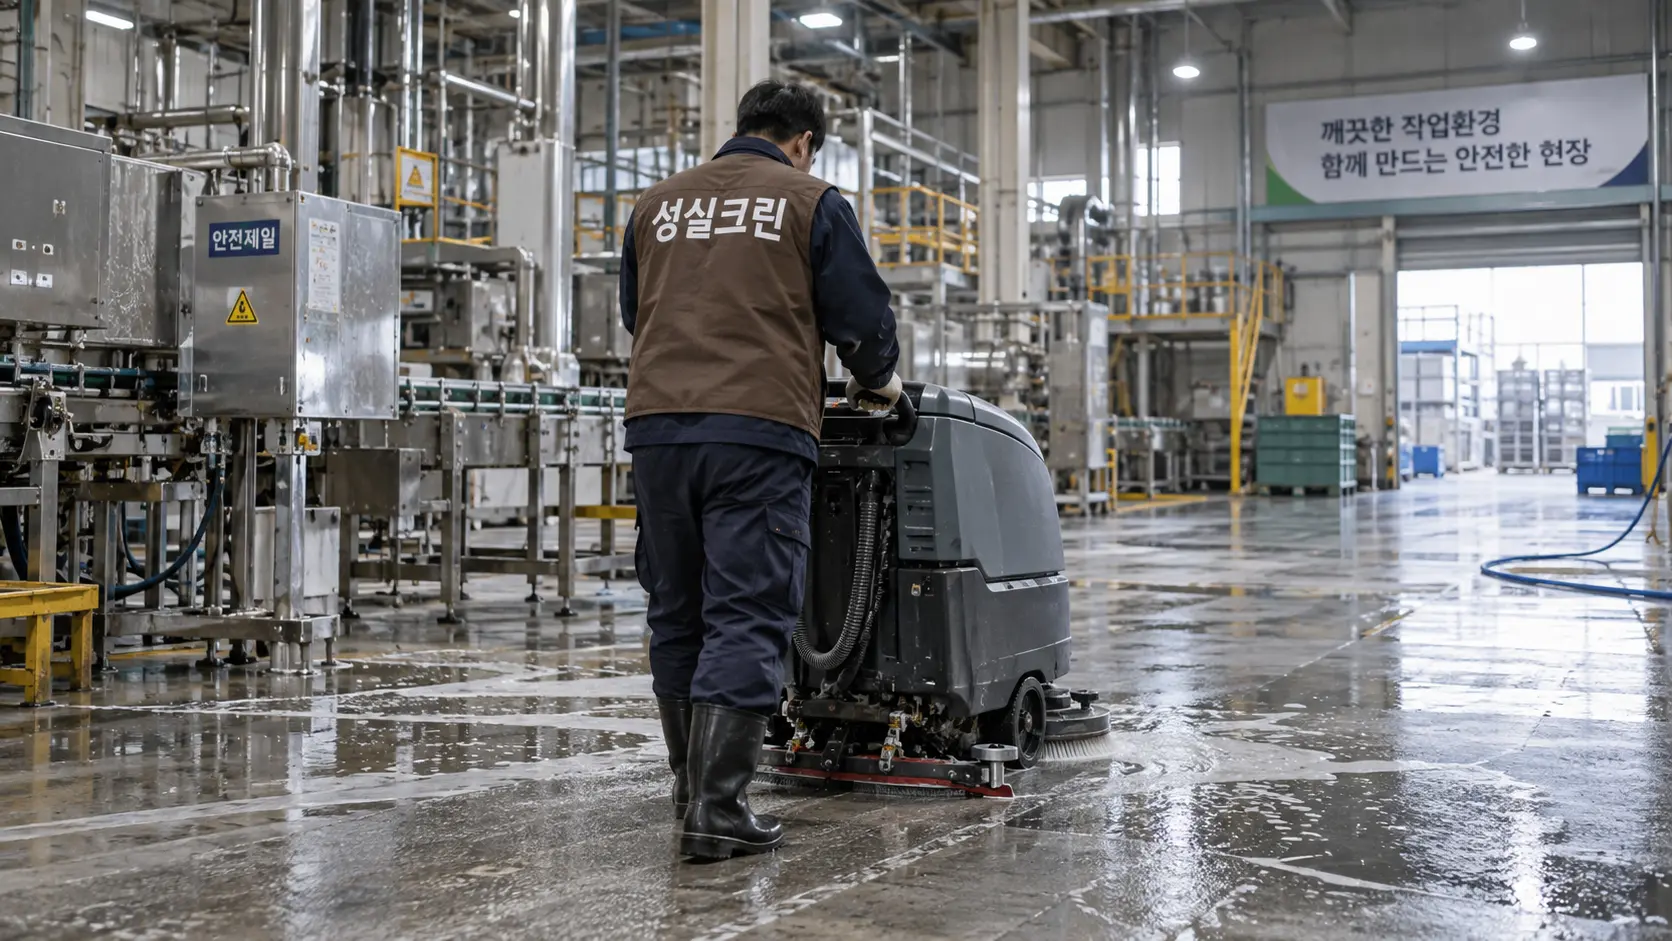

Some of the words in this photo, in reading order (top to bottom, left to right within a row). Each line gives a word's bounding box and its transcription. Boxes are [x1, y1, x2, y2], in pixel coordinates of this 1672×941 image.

[1321, 116, 1394, 145] 깨끗한
[1401, 108, 1501, 141] 작업환경
[1321, 151, 1367, 180] 함께
[1375, 148, 1448, 177] 만드는
[1455, 142, 1531, 172] 안전한
[1539, 138, 1591, 167] 현장
[212, 227, 276, 252] 안전제일
[652, 197, 787, 243] 성실크린
